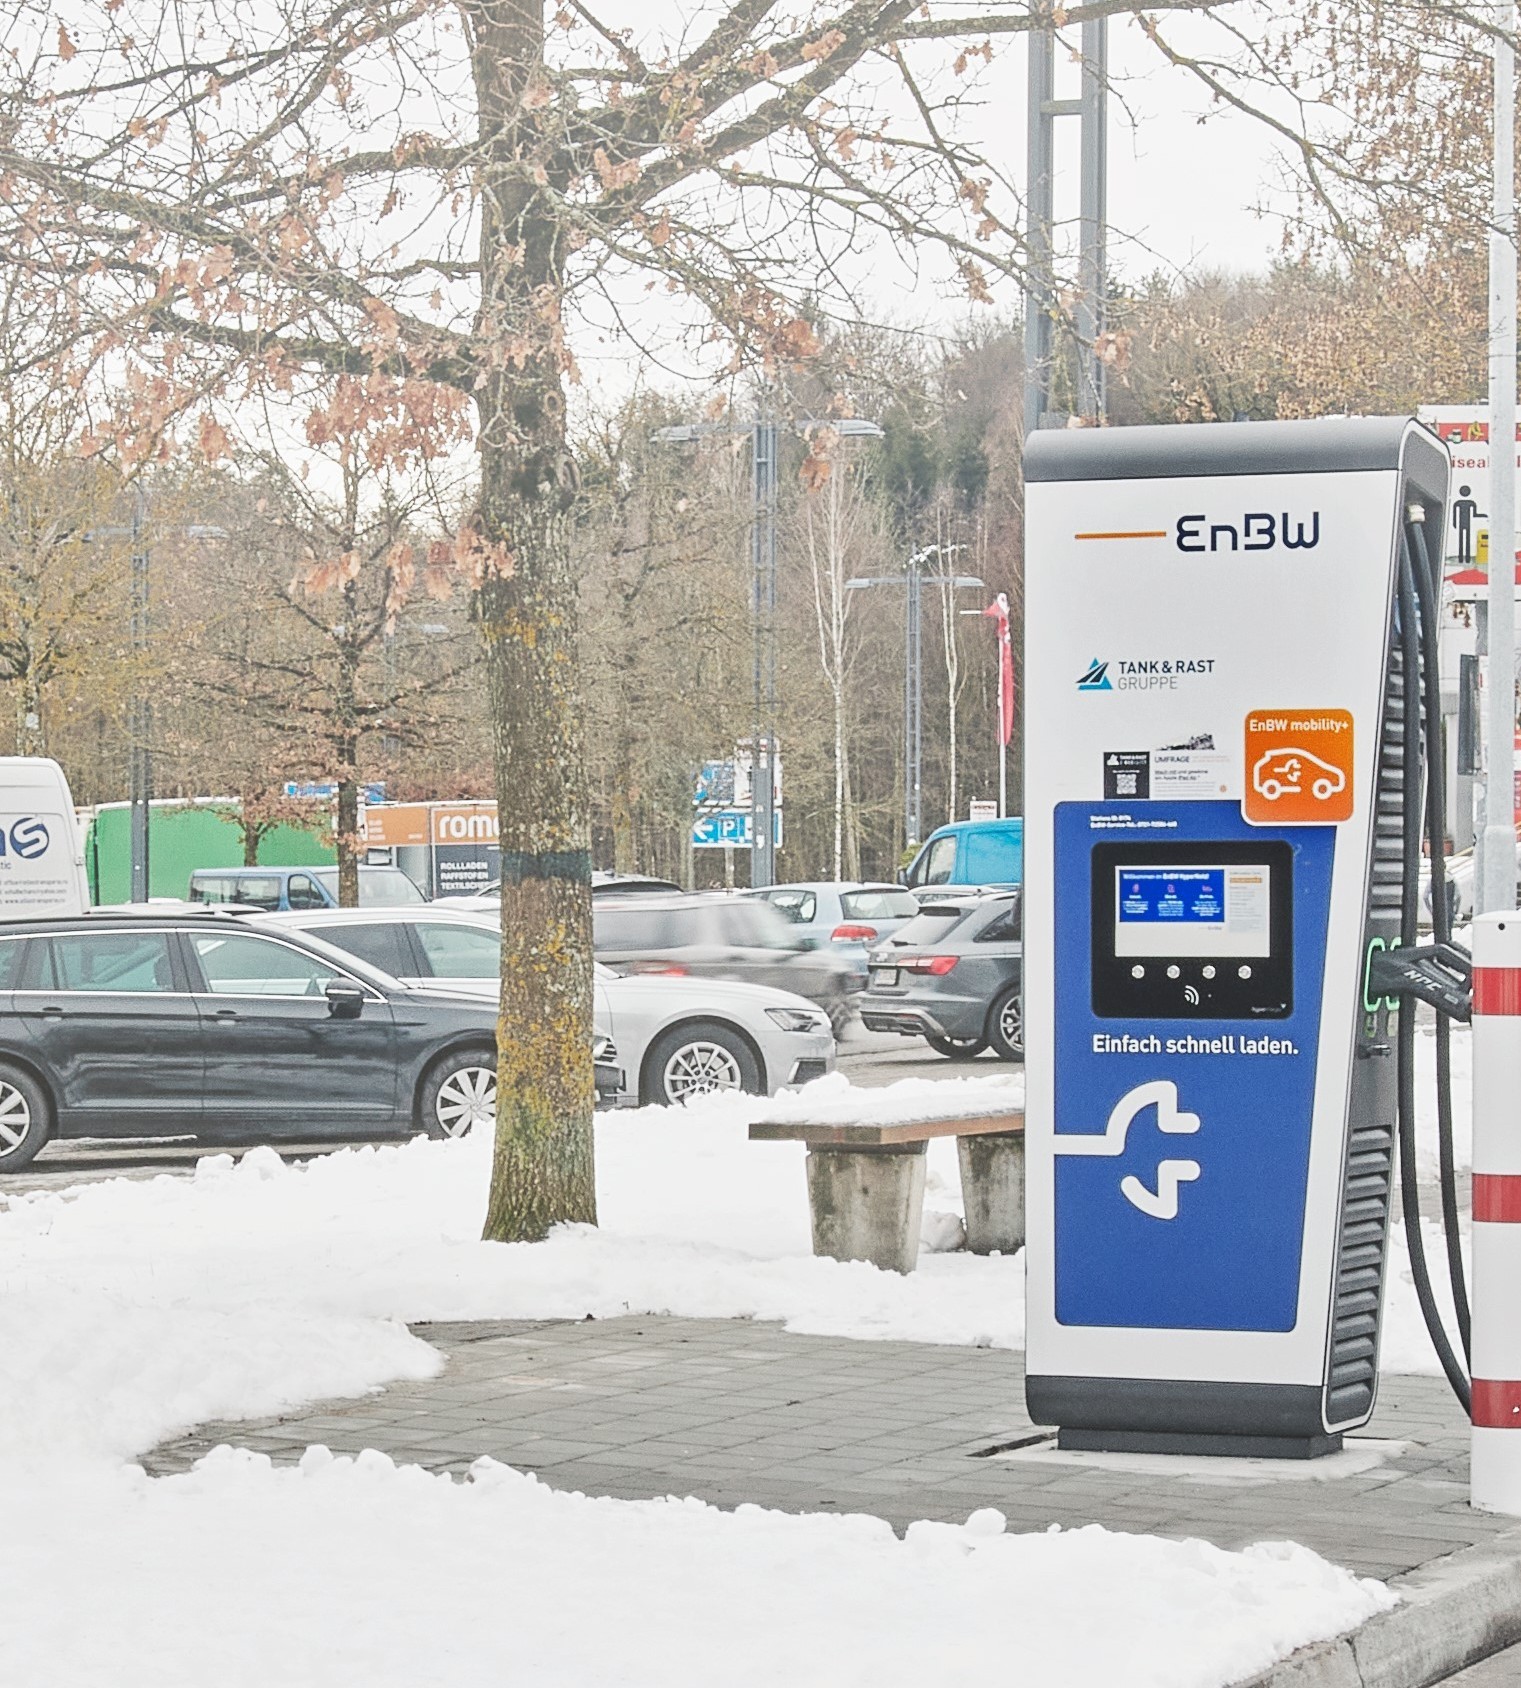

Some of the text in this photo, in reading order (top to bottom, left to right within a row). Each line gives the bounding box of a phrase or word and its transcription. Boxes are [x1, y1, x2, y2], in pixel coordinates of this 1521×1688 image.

[1176, 511, 1320, 552] EnBW
[1118, 659, 1215, 675] TANK & RAST
[1118, 675, 1178, 690] GRUPPE
[1249, 718, 1349, 733] EnBW mobility+
[1092, 1034, 1299, 1056] Einfach schnell laden.
